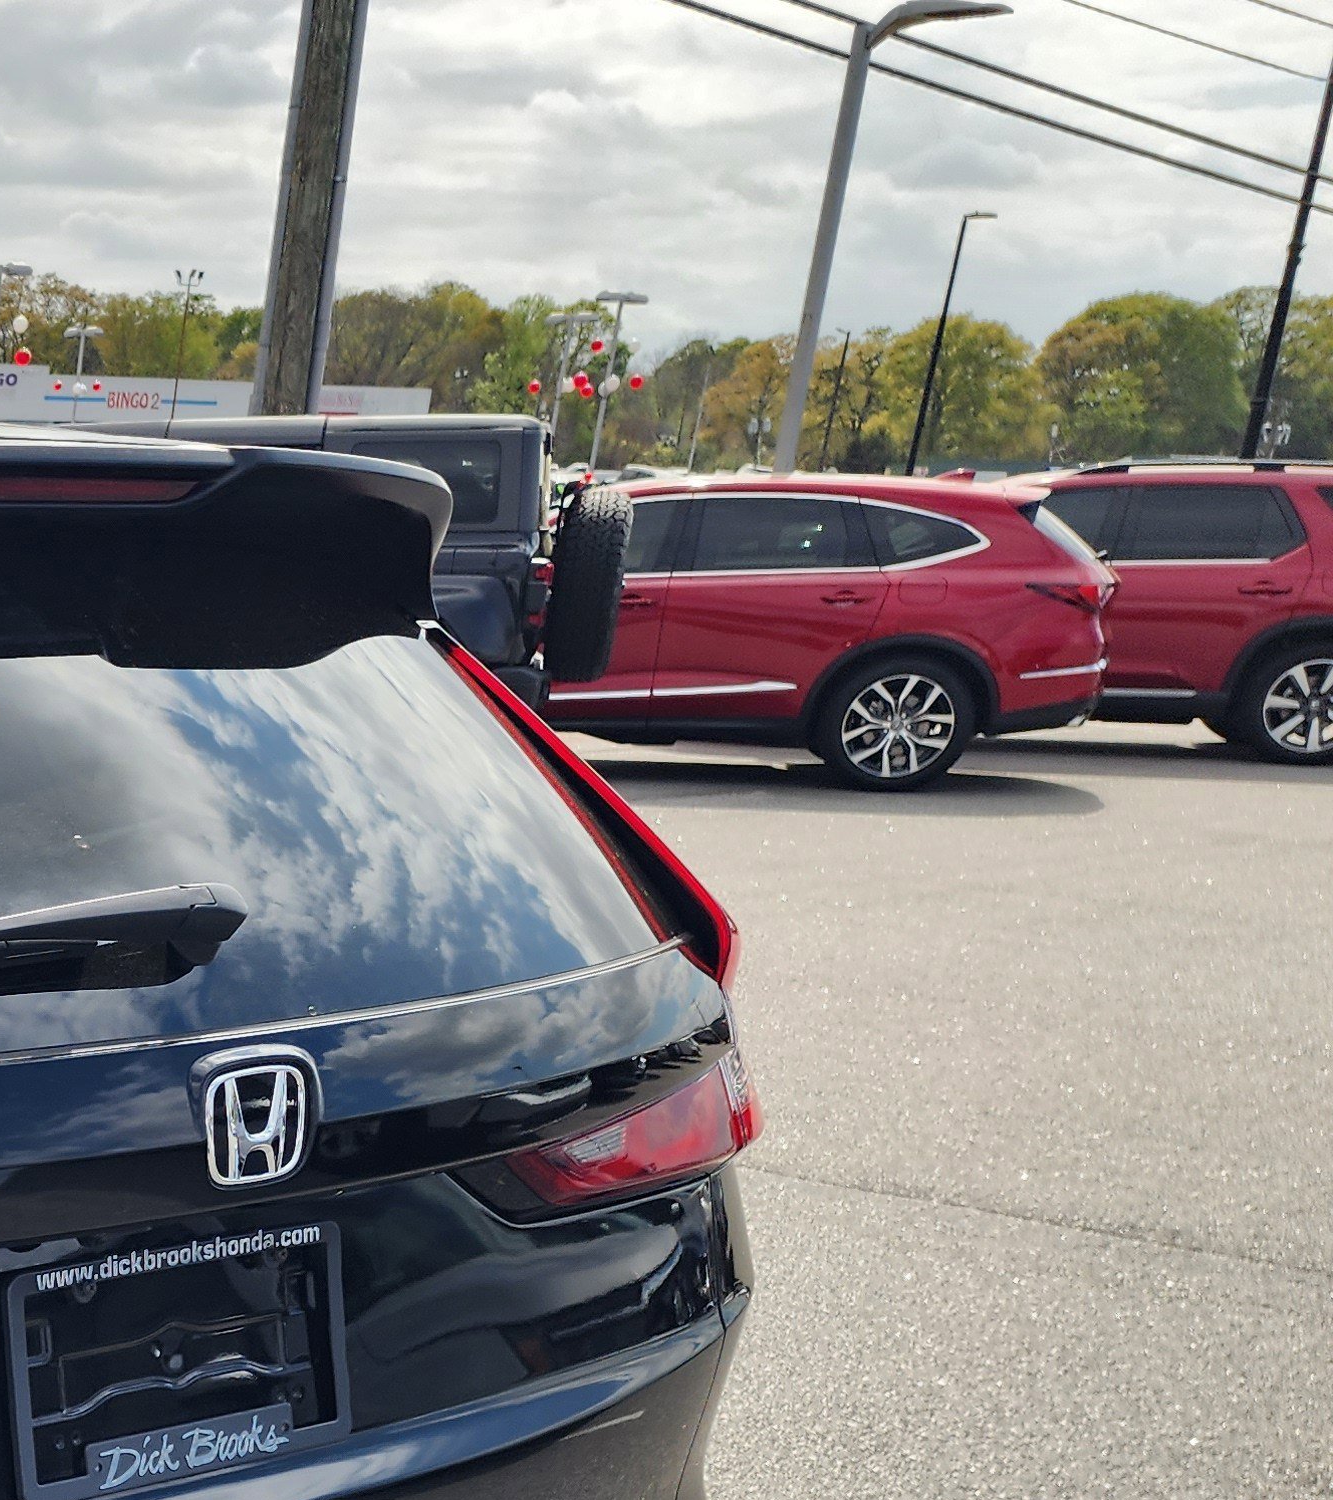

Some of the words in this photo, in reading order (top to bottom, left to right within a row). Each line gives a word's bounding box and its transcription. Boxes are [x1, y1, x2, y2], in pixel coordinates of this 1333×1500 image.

[36, 1225, 320, 1291] www.dickbrookshonda.com
[99, 1433, 180, 1490] Dick
[182, 1414, 290, 1469] Brooks
